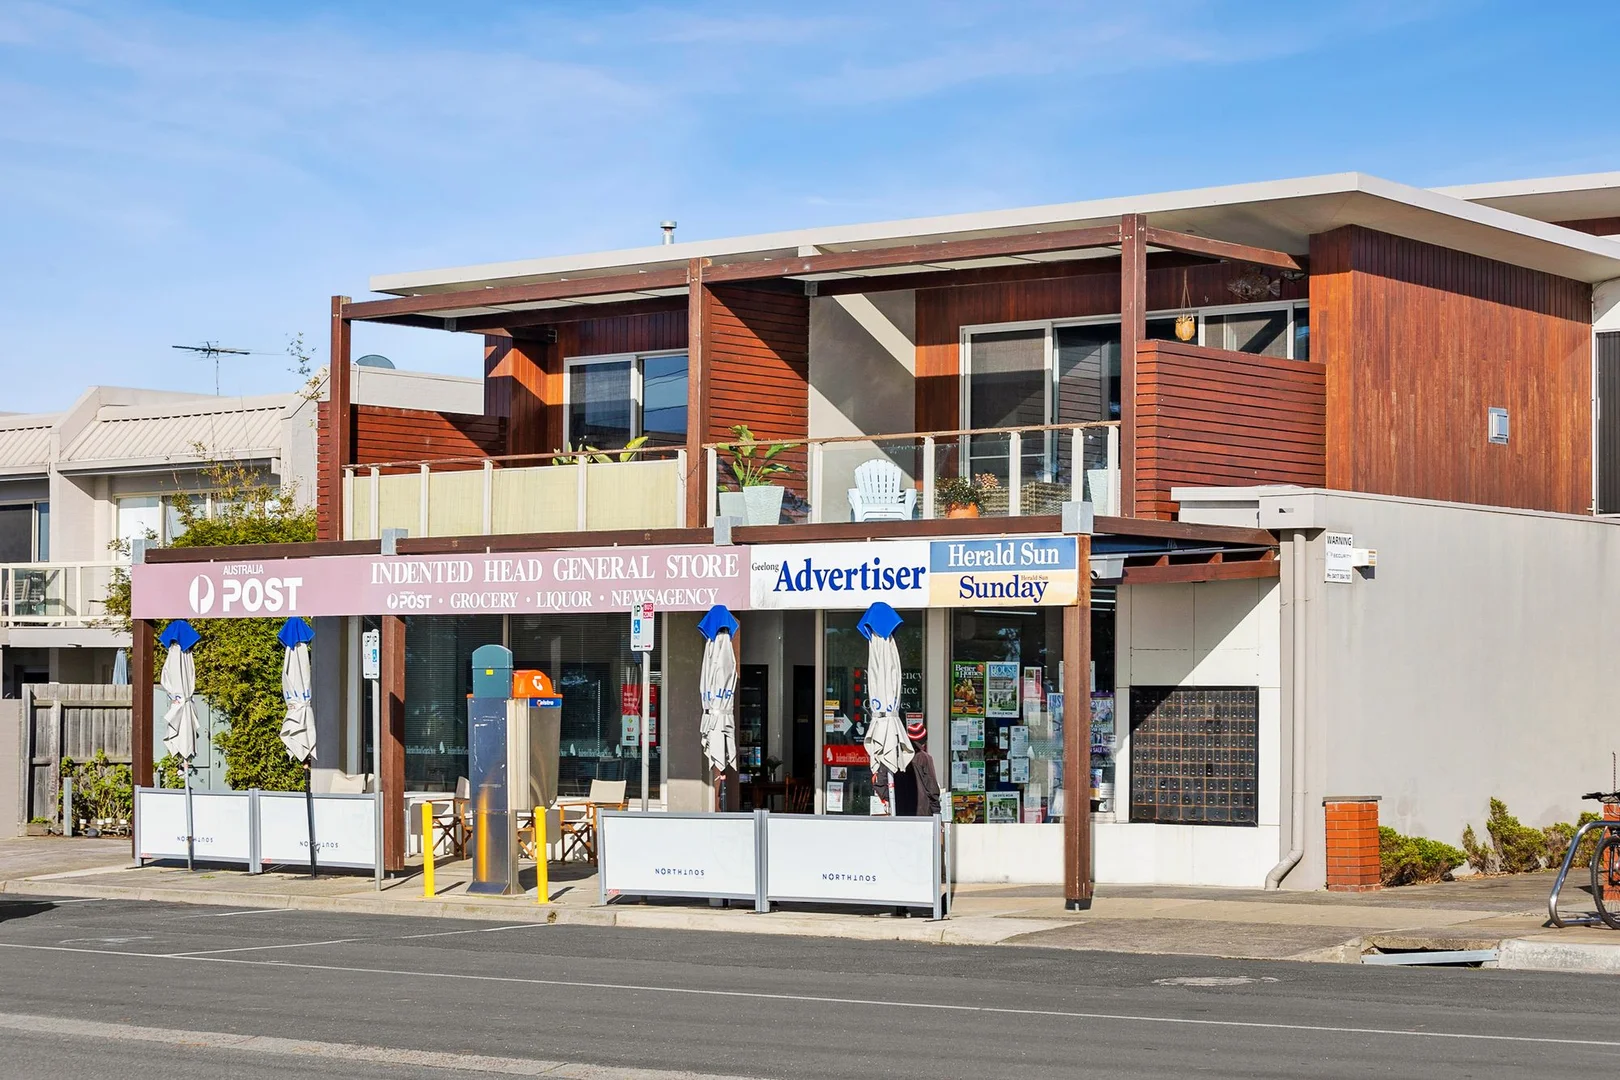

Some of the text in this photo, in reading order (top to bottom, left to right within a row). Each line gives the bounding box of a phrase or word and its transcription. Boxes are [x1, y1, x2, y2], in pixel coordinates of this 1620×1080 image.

[1327, 535, 1352, 546] WARNING
[948, 541, 1060, 567] Herald Sun
[223, 564, 264, 575] AUSTRALIA
[371, 553, 740, 584] INDENTED HEAD GENERAL STORE
[751, 562, 780, 572] Geelong
[773, 557, 927, 592] Advertiser
[222, 577, 303, 612] POST
[450, 588, 719, 610] GROCERY LIQUOR NEWSAGENCY
[959, 574, 1049, 603] Sunday
[399, 595, 432, 609] POST
